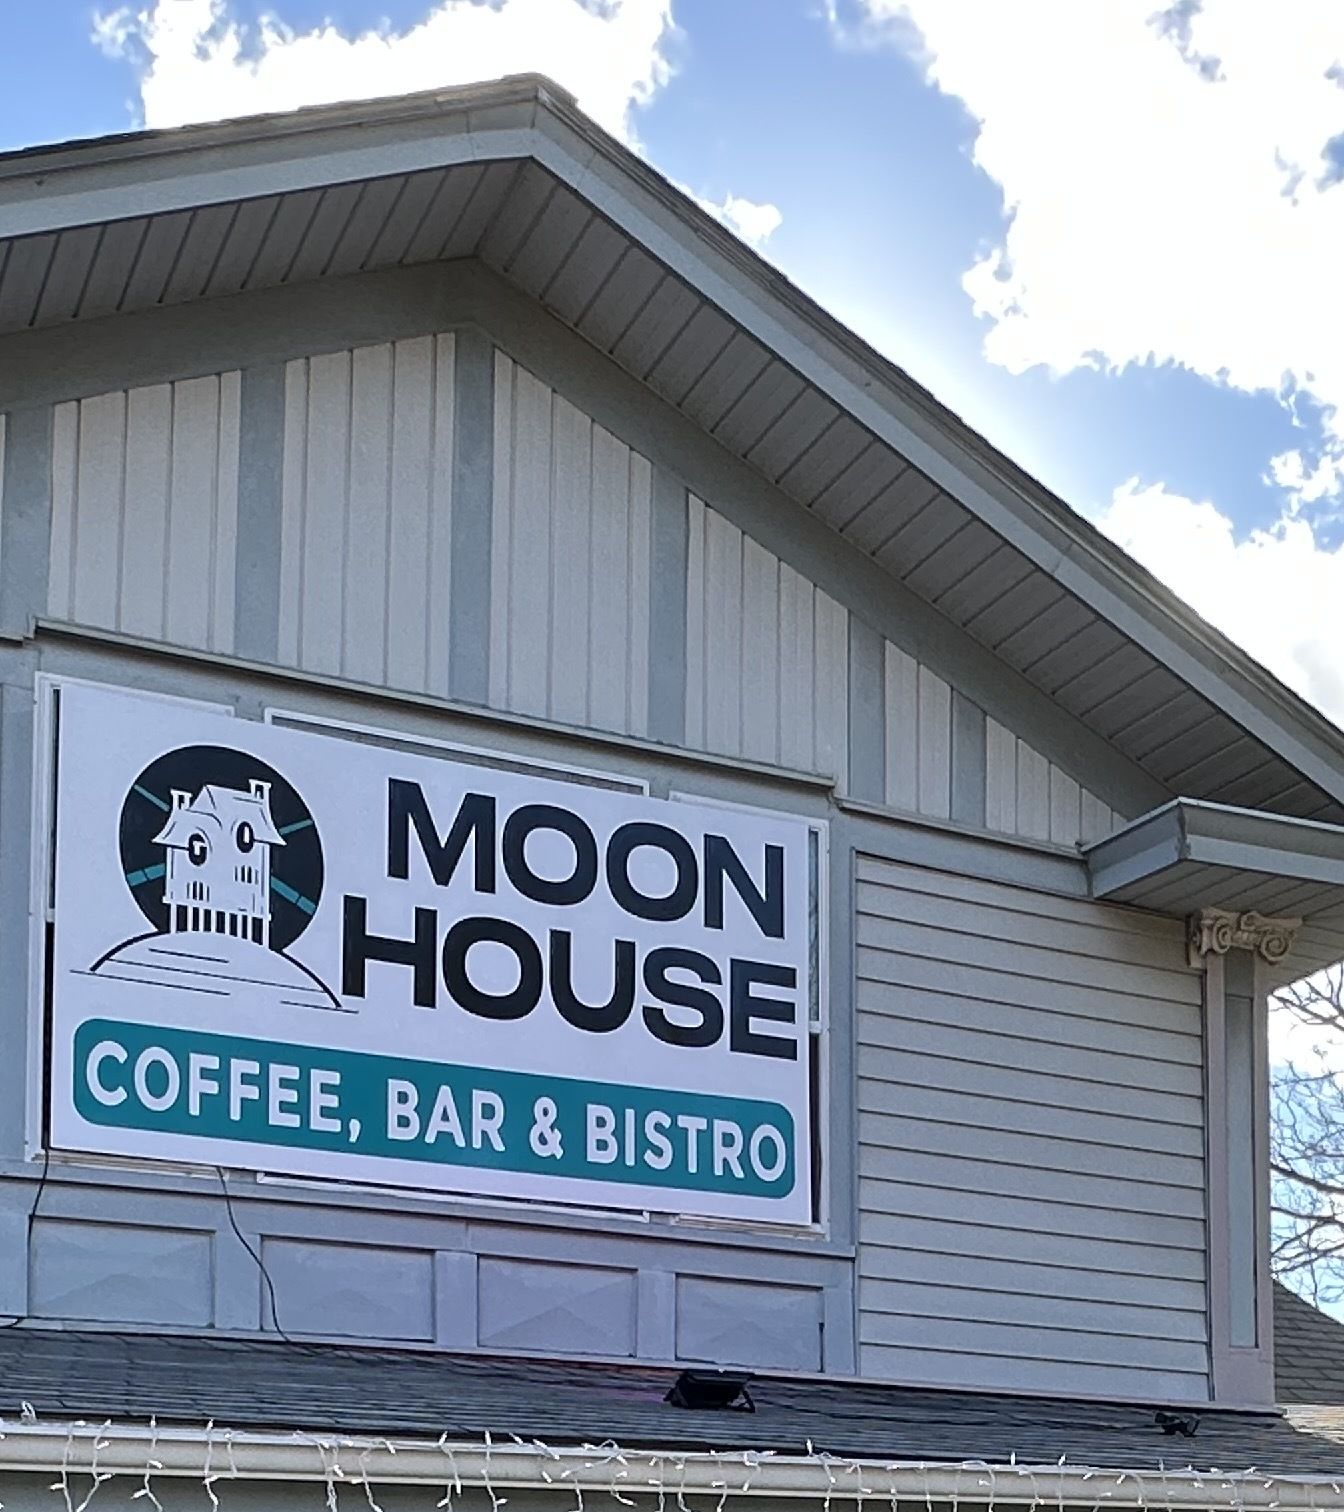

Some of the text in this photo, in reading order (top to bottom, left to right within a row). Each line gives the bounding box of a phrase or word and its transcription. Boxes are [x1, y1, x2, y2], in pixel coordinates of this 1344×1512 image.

[387, 776, 786, 940] MOON
[341, 894, 799, 1060] HOUSE
[85, 1039, 787, 1183] COFFEE, BAR & BISTRO
